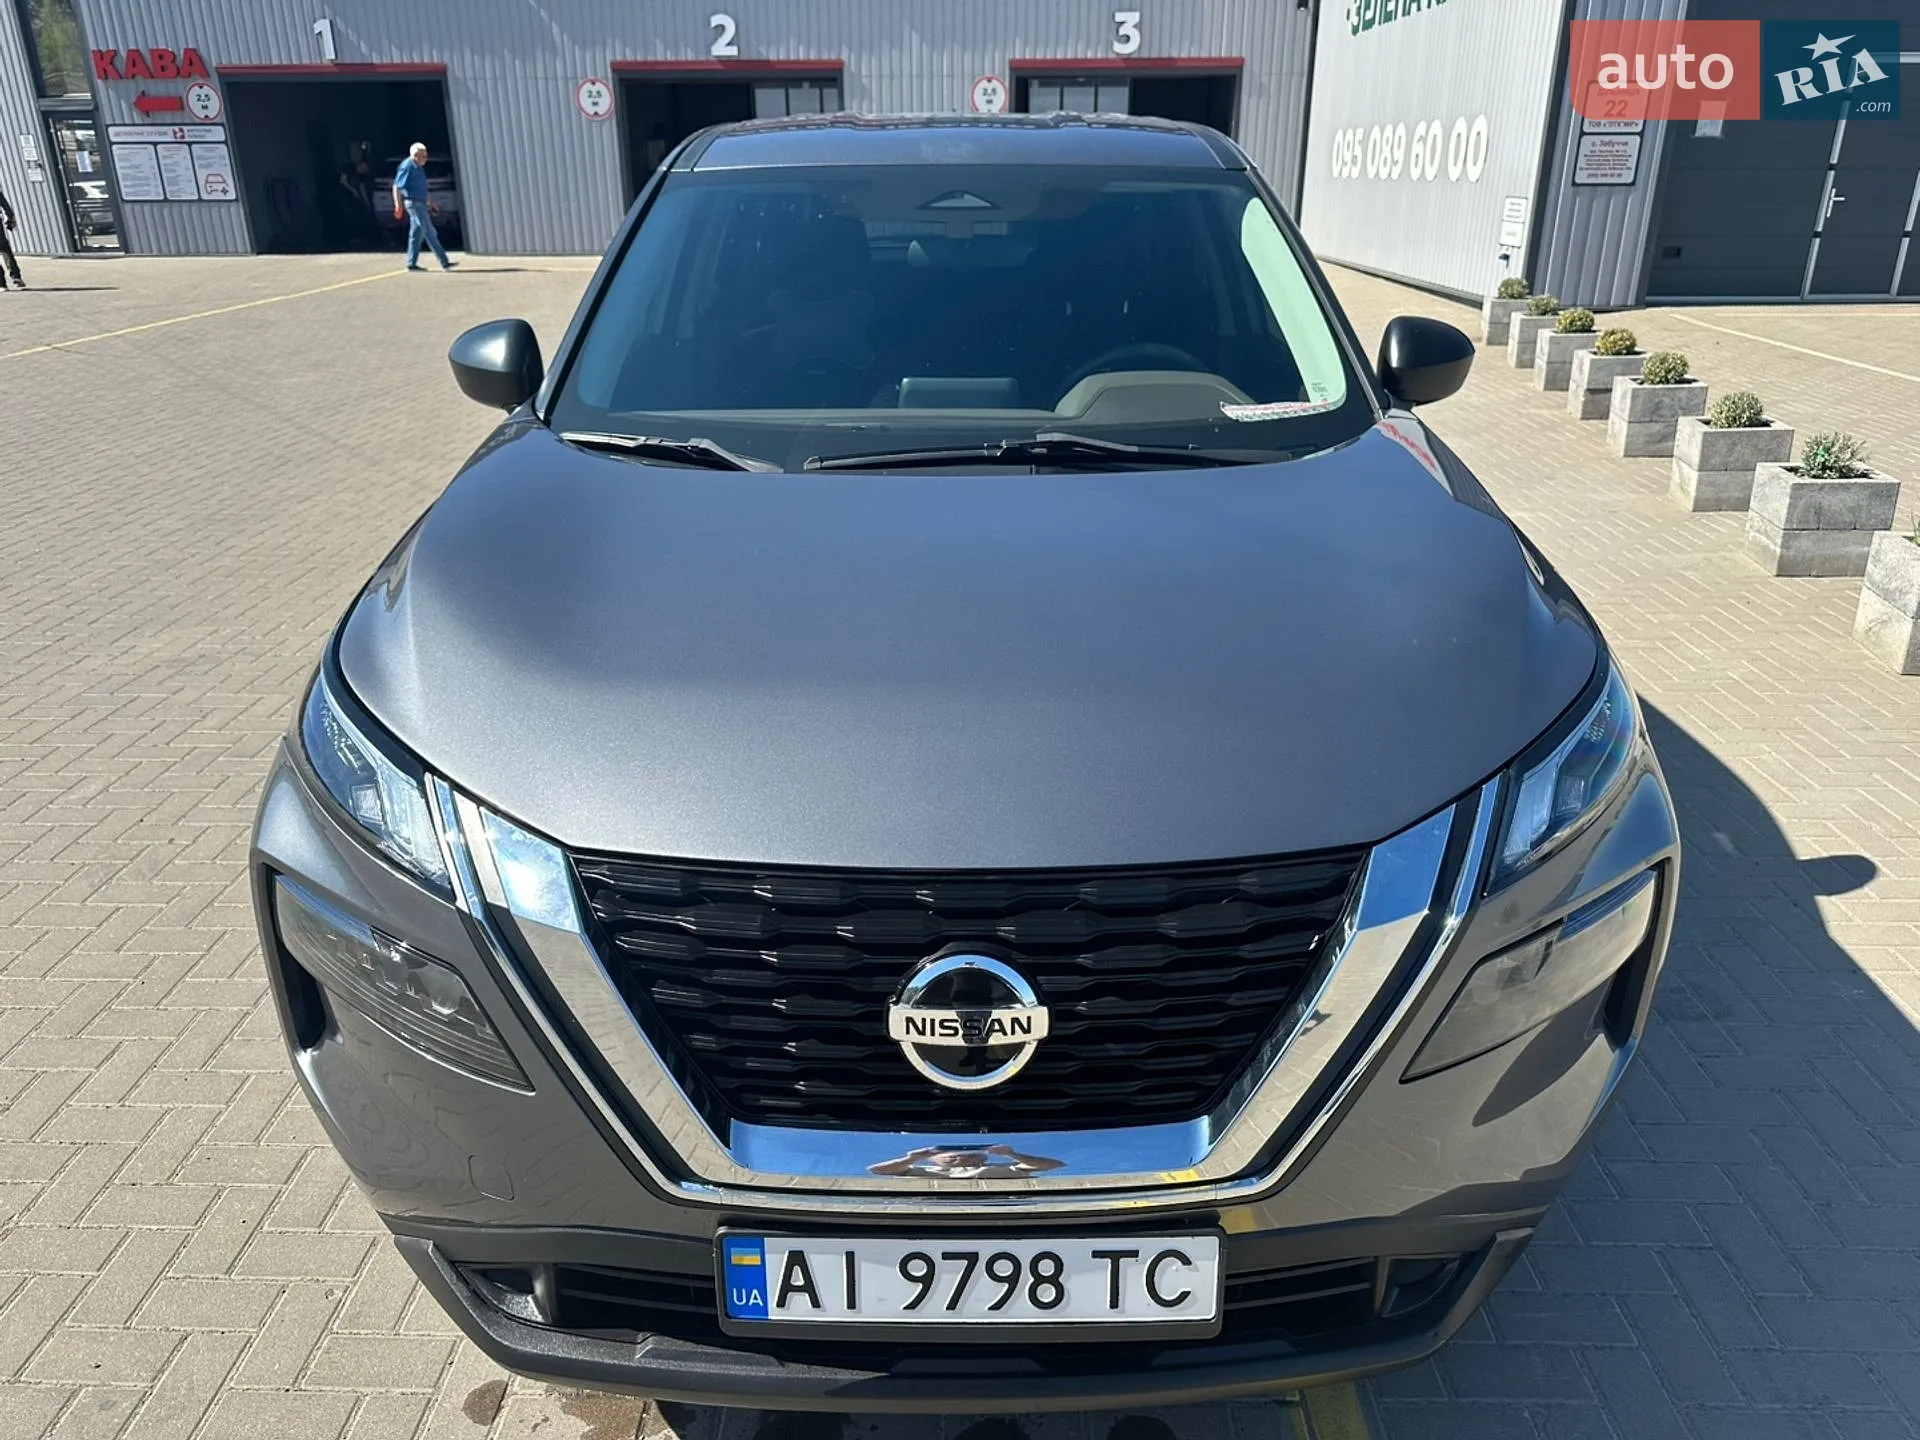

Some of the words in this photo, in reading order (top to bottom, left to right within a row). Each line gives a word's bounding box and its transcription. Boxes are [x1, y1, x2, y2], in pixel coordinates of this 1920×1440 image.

[313, 18, 336, 60] 1
[709, 13, 739, 56] 2
[1112, 11, 1141, 54] 3
[91, 48, 211, 80] КАВА
[1604, 99, 1628, 118] 22
[1332, 127, 1364, 180] 095
[1366, 121, 1406, 181] 089
[1409, 118, 1443, 182] 60
[1447, 114, 1488, 184] 00
[904, 1015, 1032, 1037] NISSAN
[732, 1287, 764, 1308] UA
[775, 1249, 858, 1310] AI
[898, 1250, 1065, 1311] 9798
[1091, 1248, 1194, 1311] TC
